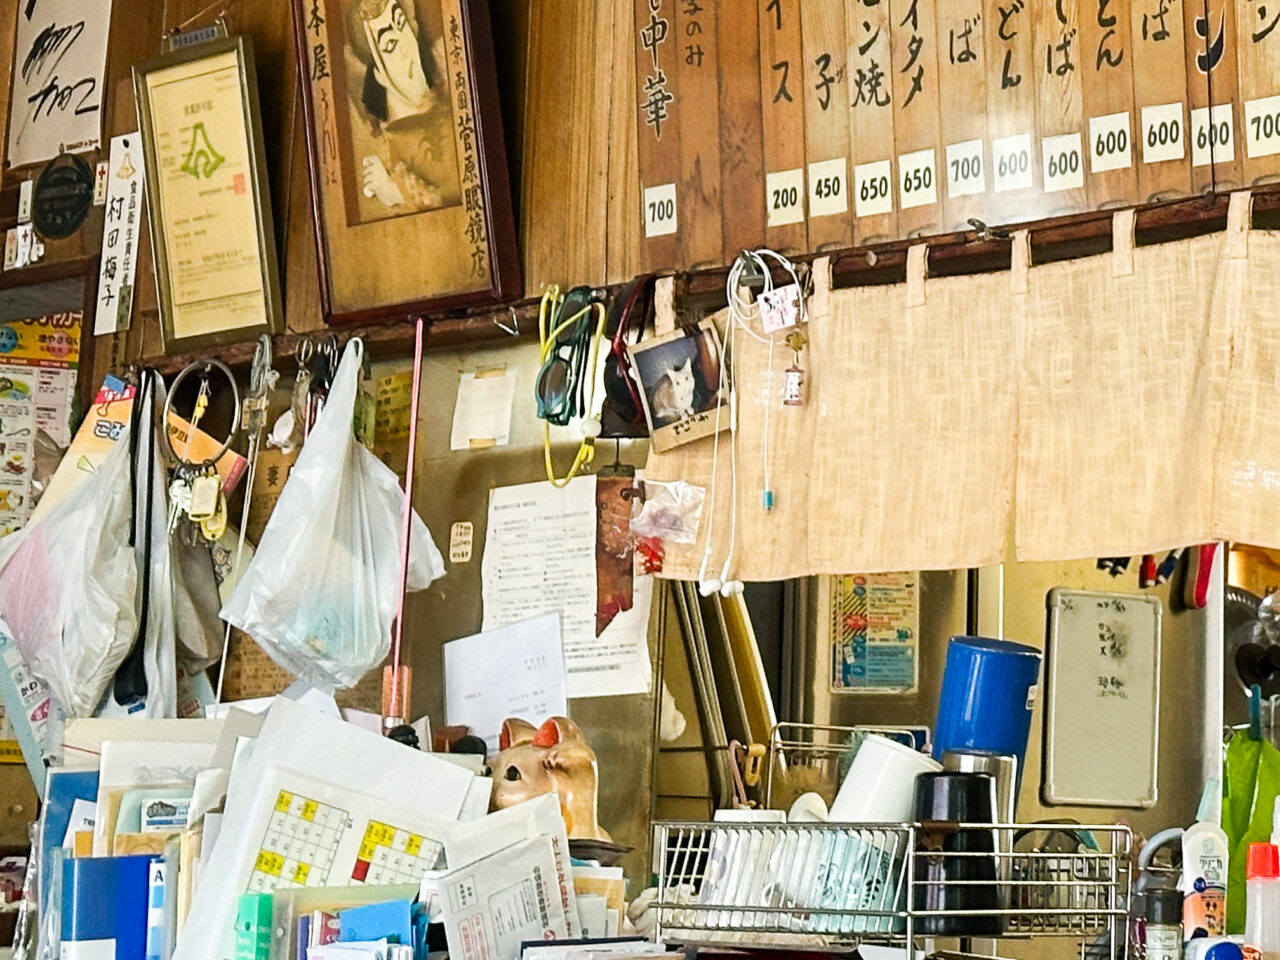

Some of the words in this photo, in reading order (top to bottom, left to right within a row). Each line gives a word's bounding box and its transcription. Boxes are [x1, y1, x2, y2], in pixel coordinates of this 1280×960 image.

[1095, 128, 1127, 154] 600
[1147, 119, 1179, 148] 600
[1196, 120, 1230, 150] 600
[951, 154, 981, 182] 700
[998, 149, 1028, 175] 600
[1048, 150, 1079, 176] 600
[815, 175, 841, 199] 450
[860, 176, 889, 202] 650
[904, 166, 933, 193] 650
[648, 198, 675, 224] 700
[772, 186, 798, 210] 200
